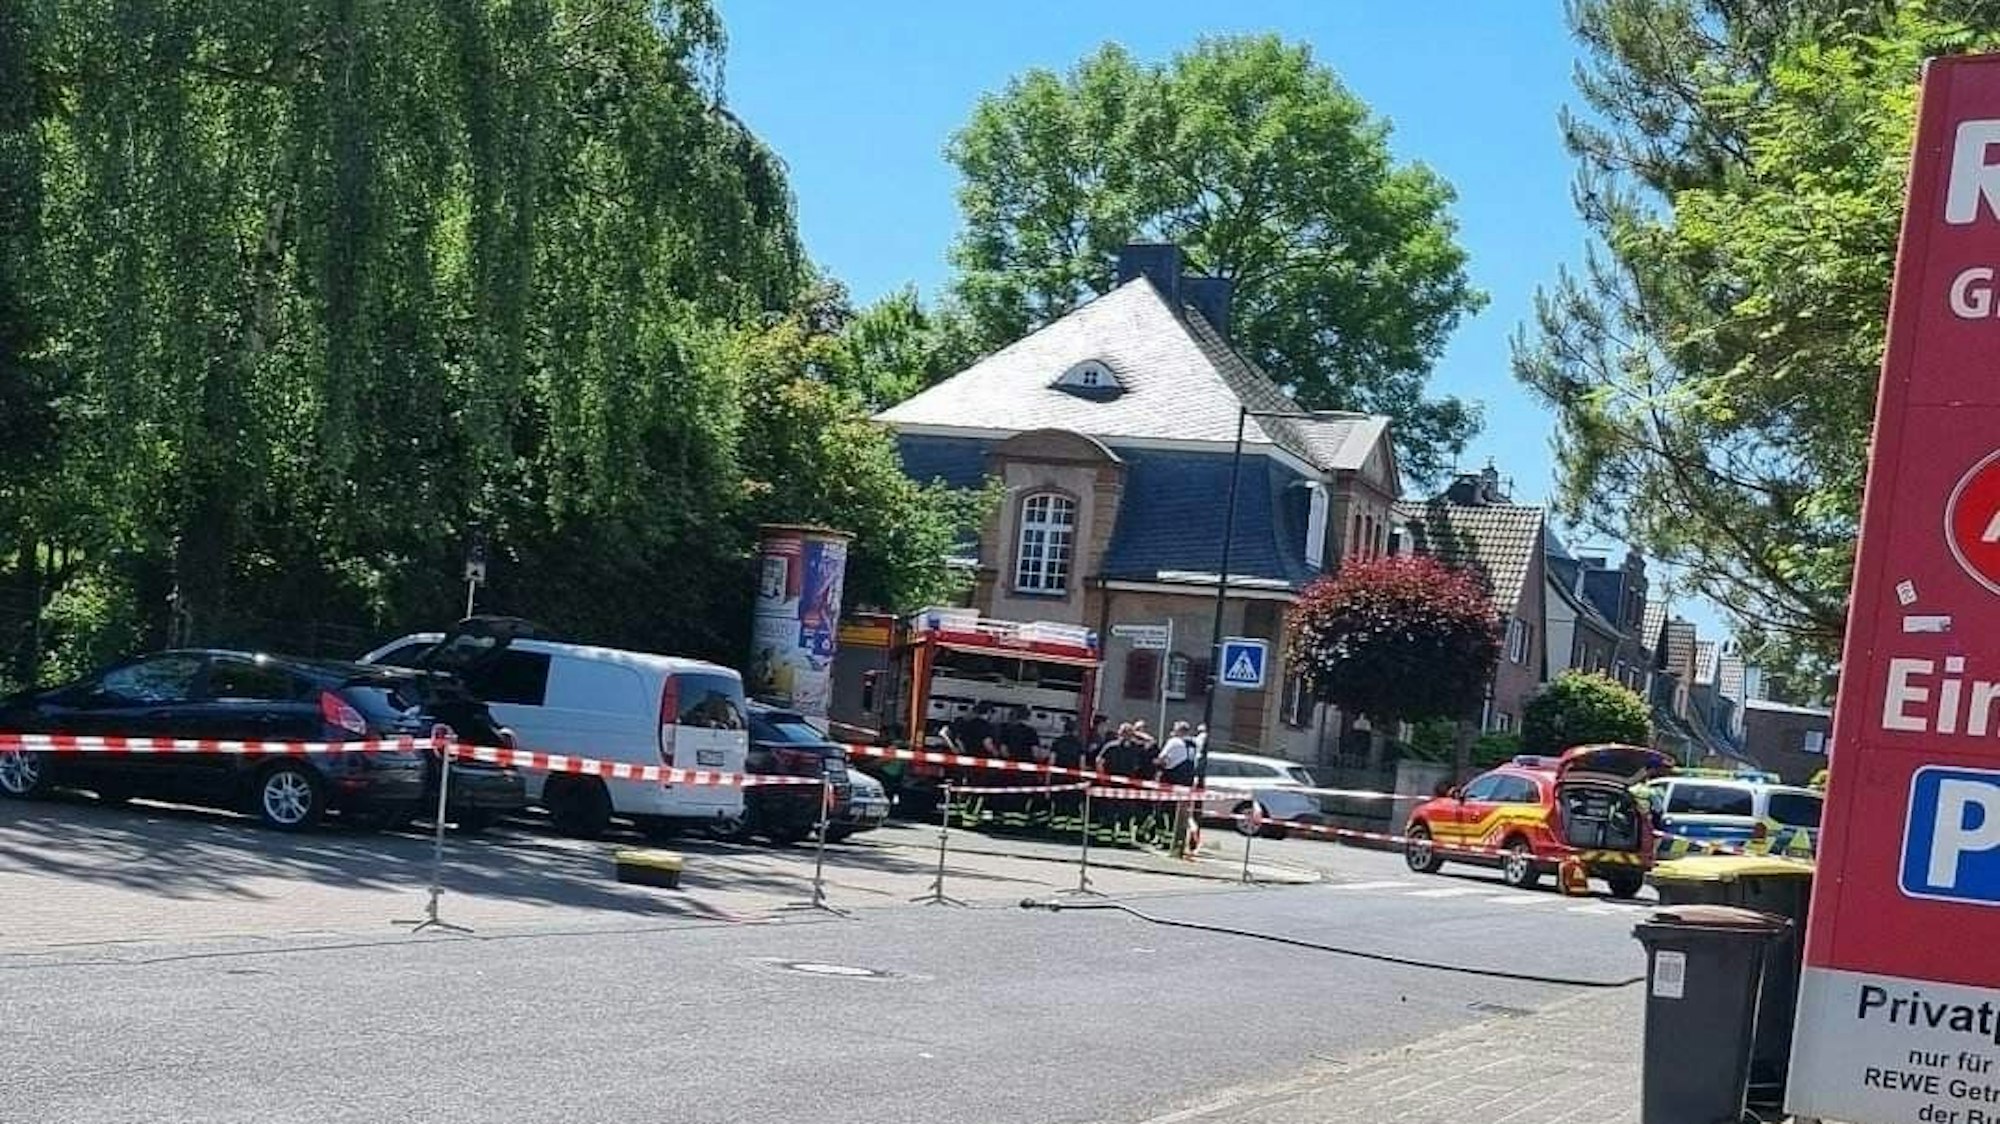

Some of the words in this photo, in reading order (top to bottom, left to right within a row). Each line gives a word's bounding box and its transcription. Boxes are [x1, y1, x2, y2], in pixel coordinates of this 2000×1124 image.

[1950, 267, 2000, 318] G
[1927, 779, 2000, 888] P
[1858, 985, 2000, 1045] Privat
[1865, 1067, 1940, 1095] REWE
[1909, 1050, 1950, 1068] nur
[1958, 1052, 1993, 1074] für
[1919, 1103, 1959, 1124] der
